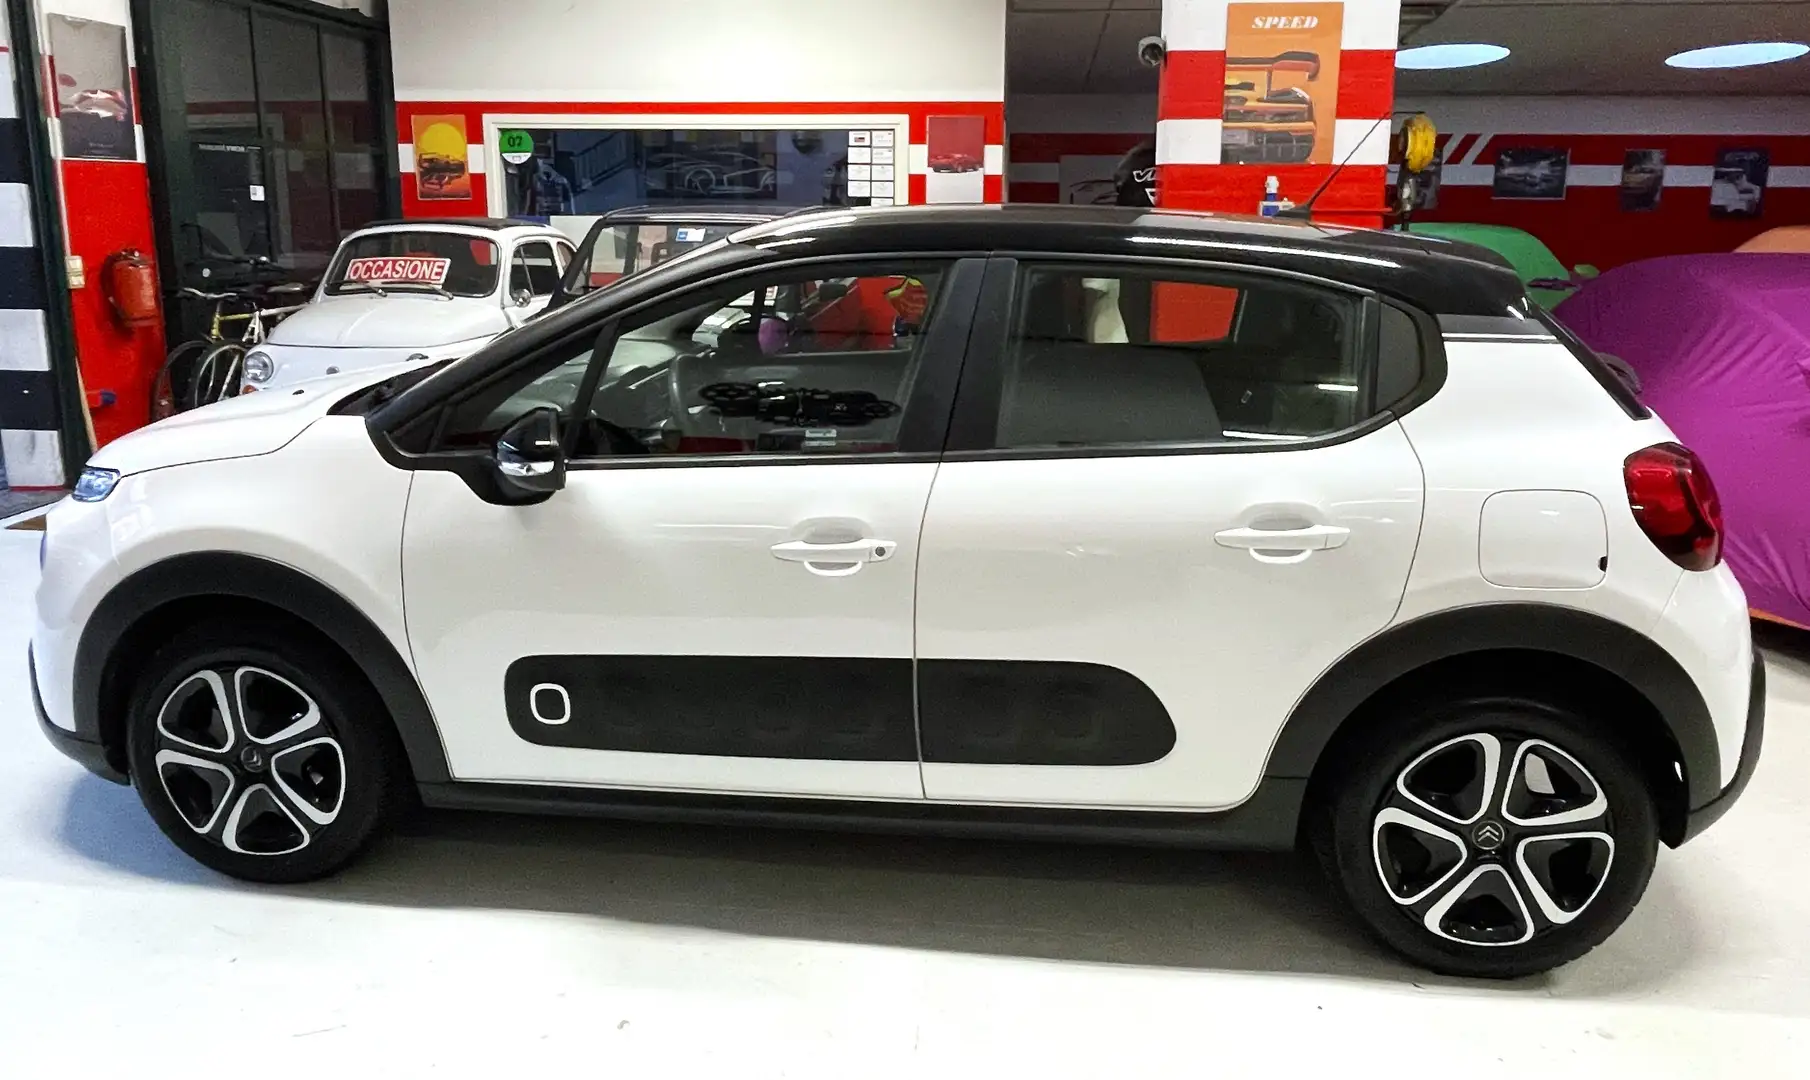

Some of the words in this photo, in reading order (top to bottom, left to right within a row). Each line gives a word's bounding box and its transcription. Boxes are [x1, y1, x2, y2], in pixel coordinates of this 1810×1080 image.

[1251, 15, 1319, 29] SPEED
[507, 135, 523, 148] 07
[349, 260, 446, 280] OCCASIONE
